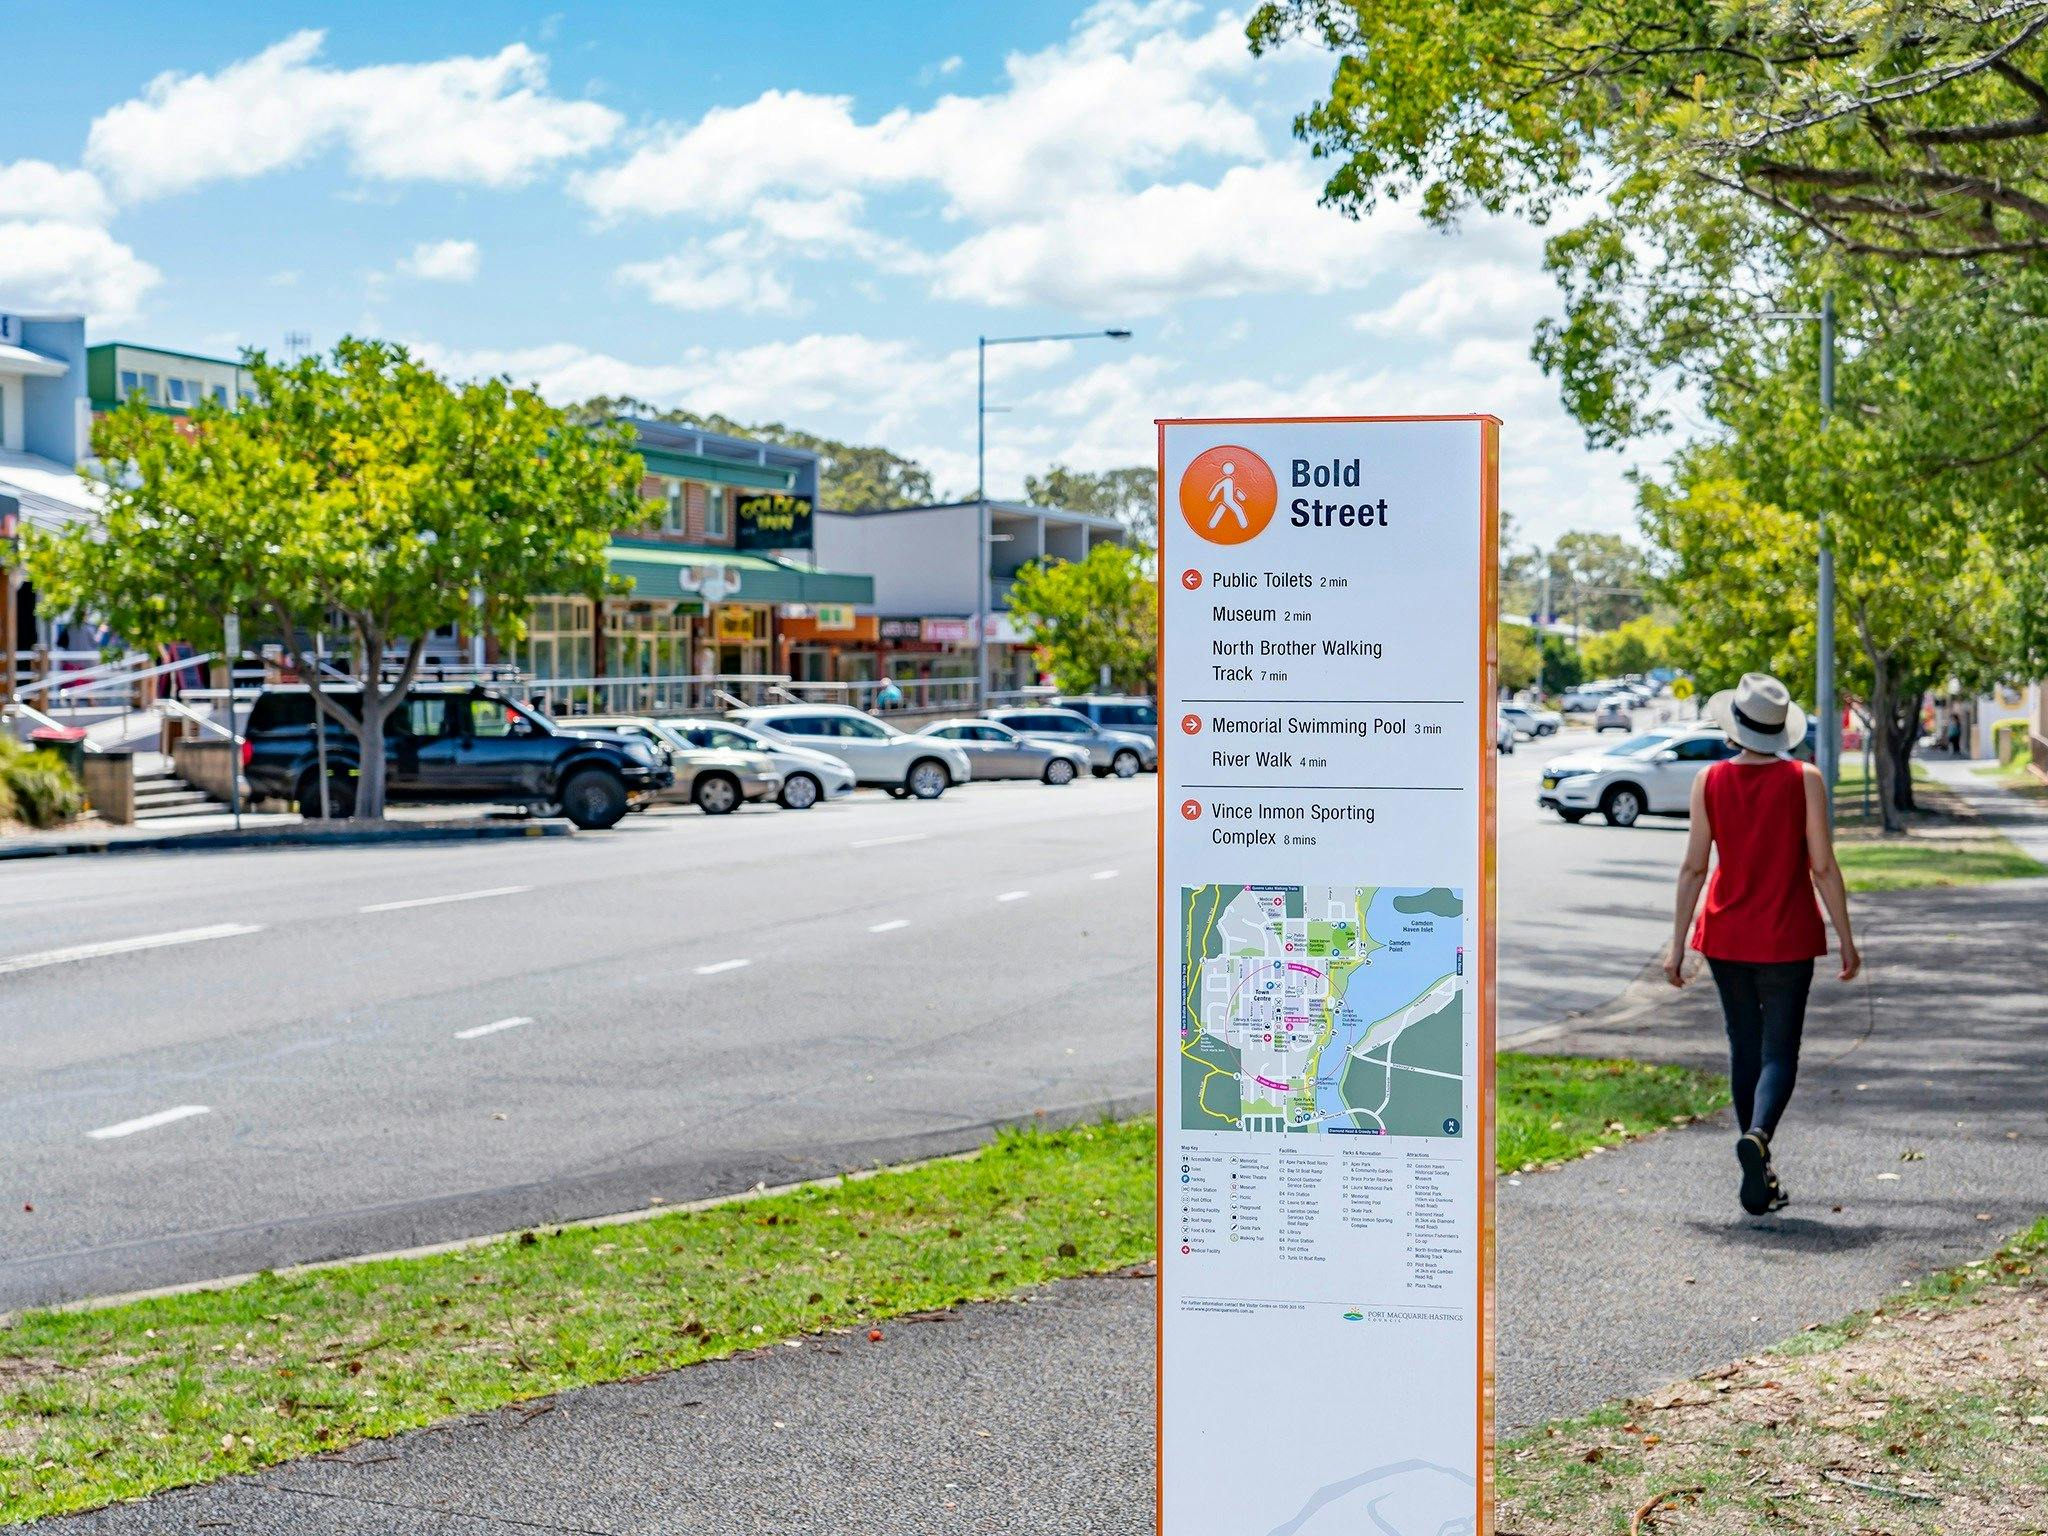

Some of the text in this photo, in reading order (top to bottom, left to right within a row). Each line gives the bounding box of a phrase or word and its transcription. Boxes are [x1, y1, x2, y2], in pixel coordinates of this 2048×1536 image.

[1292, 459, 1360, 487] Bold
[1291, 498, 1388, 527] Street
[1213, 572, 1347, 588] Public Toilets 2 min
[1213, 607, 1311, 622] Museum 2 min
[1213, 641, 1382, 658] North Brother Walking
[1213, 666, 1287, 681] Track 7 min
[1213, 718, 1441, 737] Memorial Swimming Pool 3 min
[1212, 752, 1326, 767] River Walk 4 min
[1212, 804, 1375, 822] Vince Inmon Sporting
[1212, 829, 1316, 847] Complex 8 mins
[1387, 1312, 1463, 1321] MACQUARIE-HASTINGS
